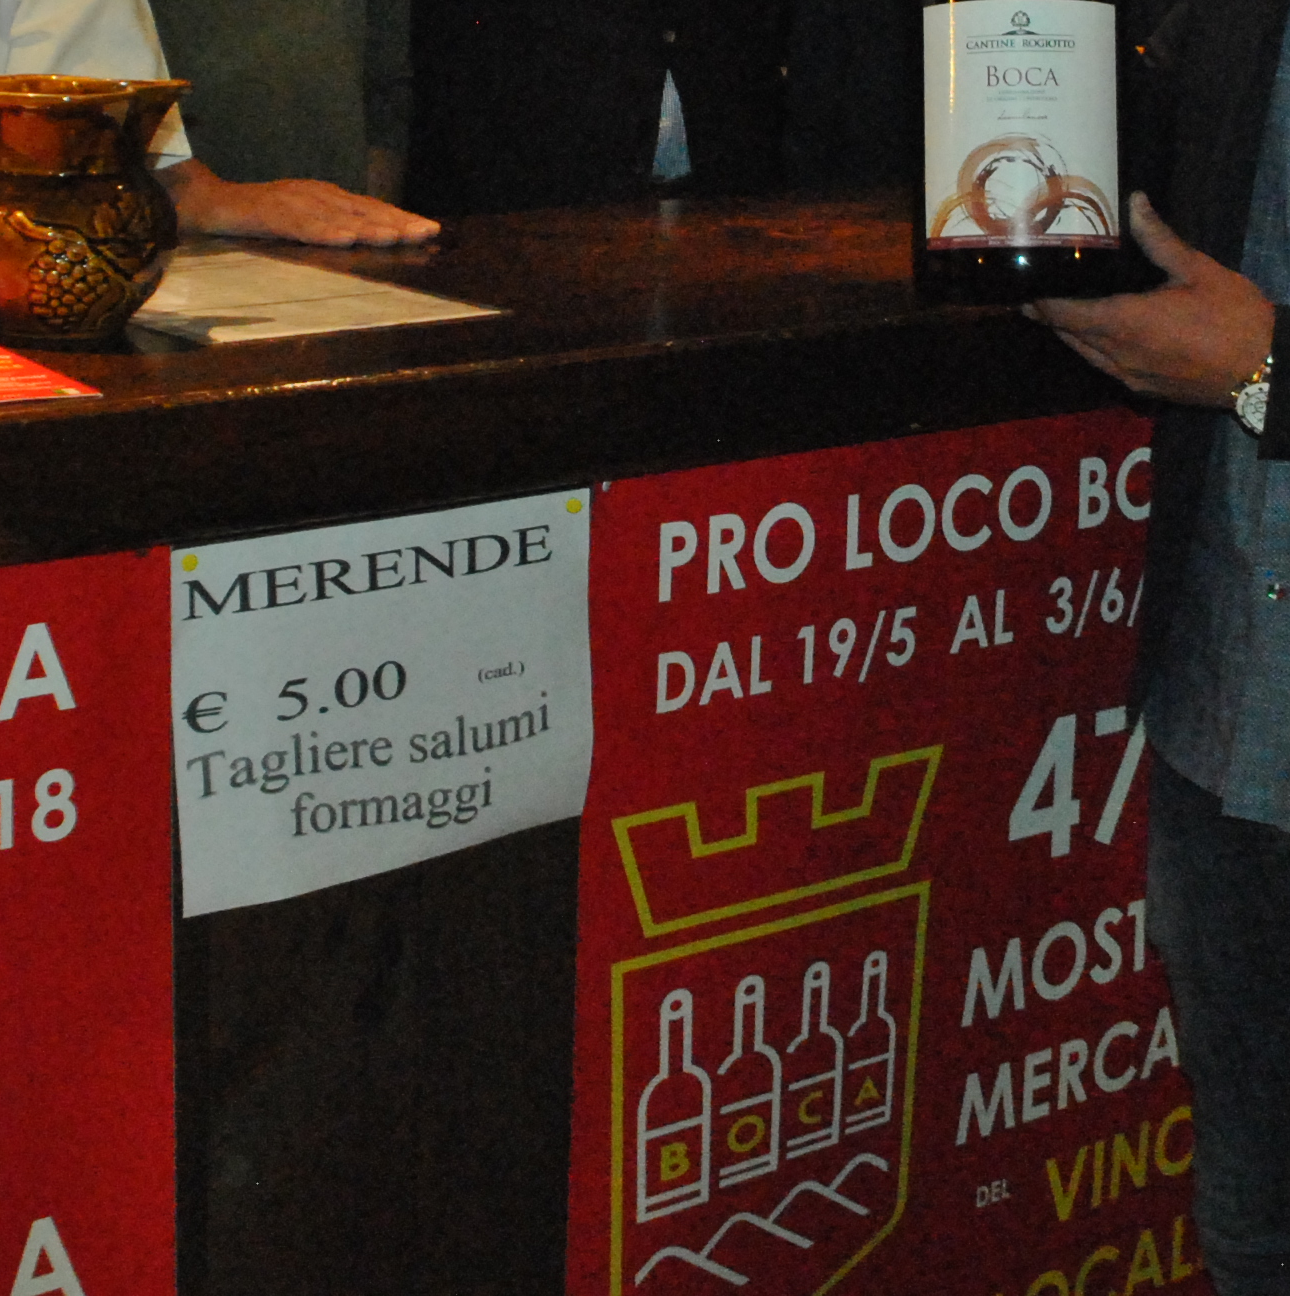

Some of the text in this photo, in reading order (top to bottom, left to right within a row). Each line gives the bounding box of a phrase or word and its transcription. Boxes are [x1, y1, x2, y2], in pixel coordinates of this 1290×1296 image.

[966, 38, 1076, 51] CANTINE ROGIOTTO
[986, 65, 1059, 87] BOCA
[181, 524, 553, 621] MERENDE
[658, 502, 816, 603] PRO
[845, 465, 1053, 571] LOCO
[655, 634, 773, 715] DAL
[797, 606, 917, 684] 19/5
[950, 589, 1014, 655] AL
[182, 660, 526, 734] € 5.00 (cad.)
[186, 690, 550, 800] Tagliere salumi
[290, 765, 493, 837] formaggi
[955, 1006, 1181, 1146] MERCA
[975, 1178, 1011, 1208] DEL
